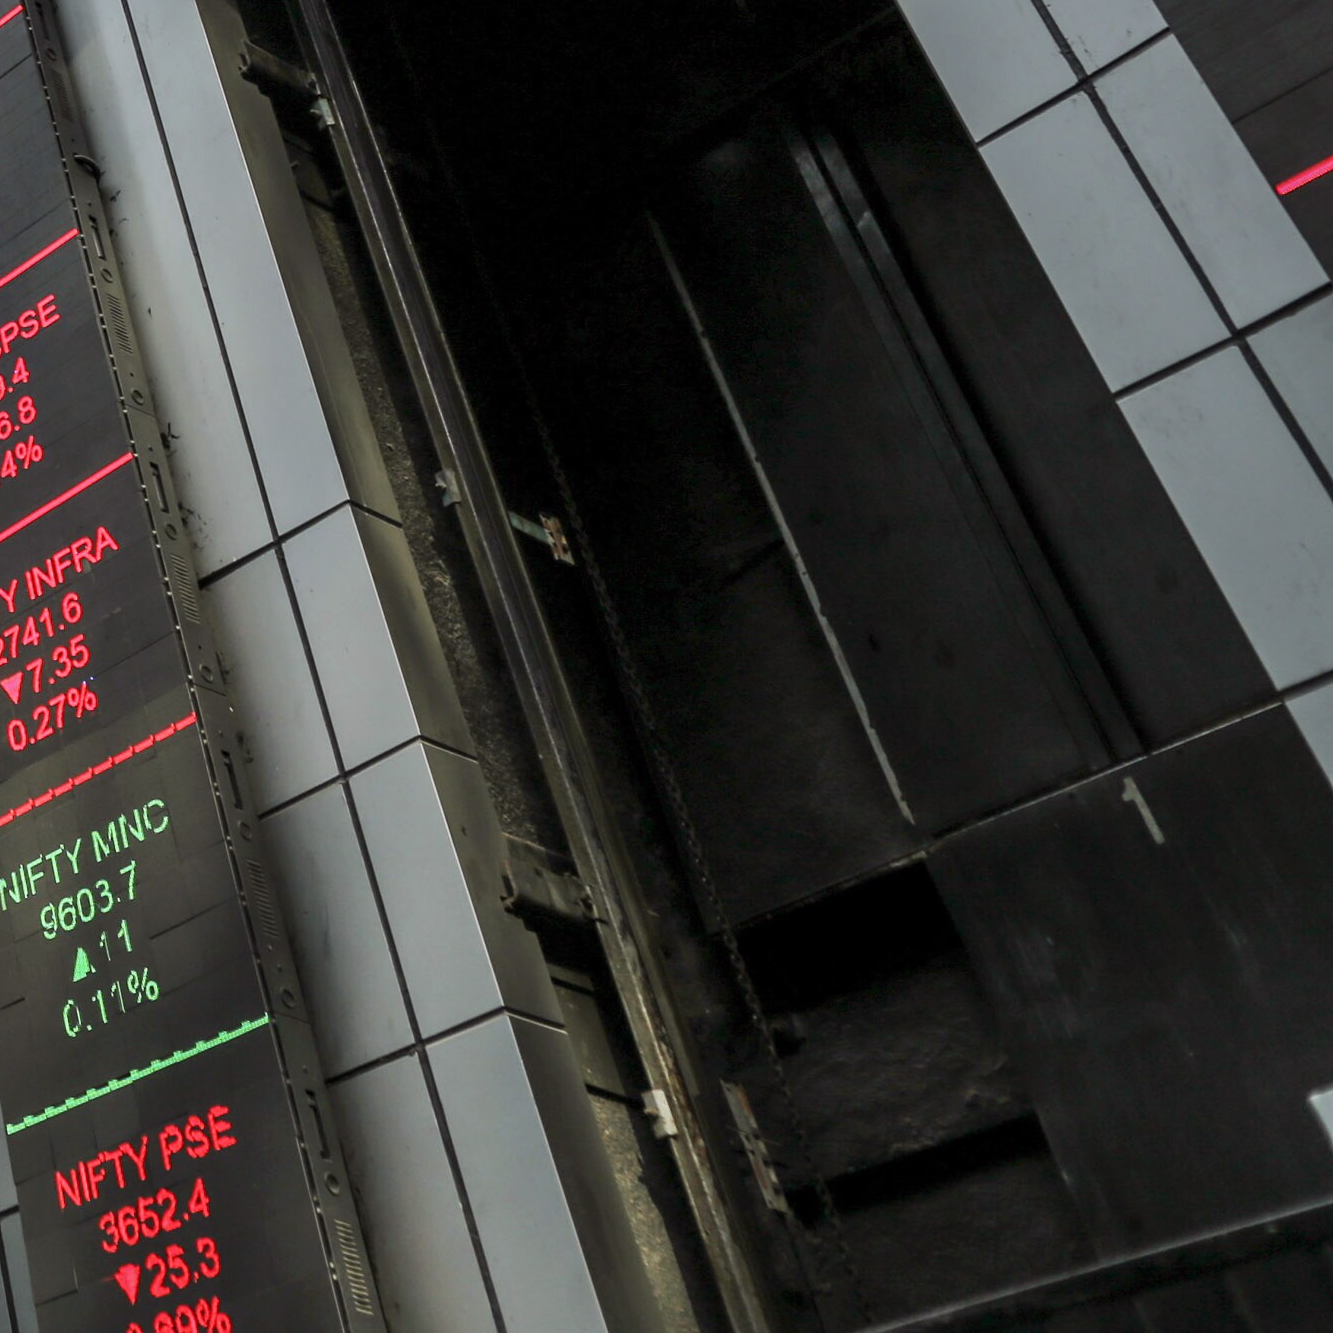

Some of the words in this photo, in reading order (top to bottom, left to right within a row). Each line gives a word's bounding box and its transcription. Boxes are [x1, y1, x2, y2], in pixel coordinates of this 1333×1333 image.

[25, 526, 119, 599] INFRA
[27, 634, 90, 692] 7.35
[7, 683, 98, 751] 0.27%
[92, 798, 171, 863] MNC
[40, 861, 136, 940] 9603.7
[99, 920, 133, 961] 11
[63, 967, 159, 1038] 0.11%
[55, 1135, 148, 1209] NIFTY
[160, 1106, 236, 1169] PSE
[99, 1178, 210, 1253] 3652.4
[146, 1237, 221, 1298] 25.3
